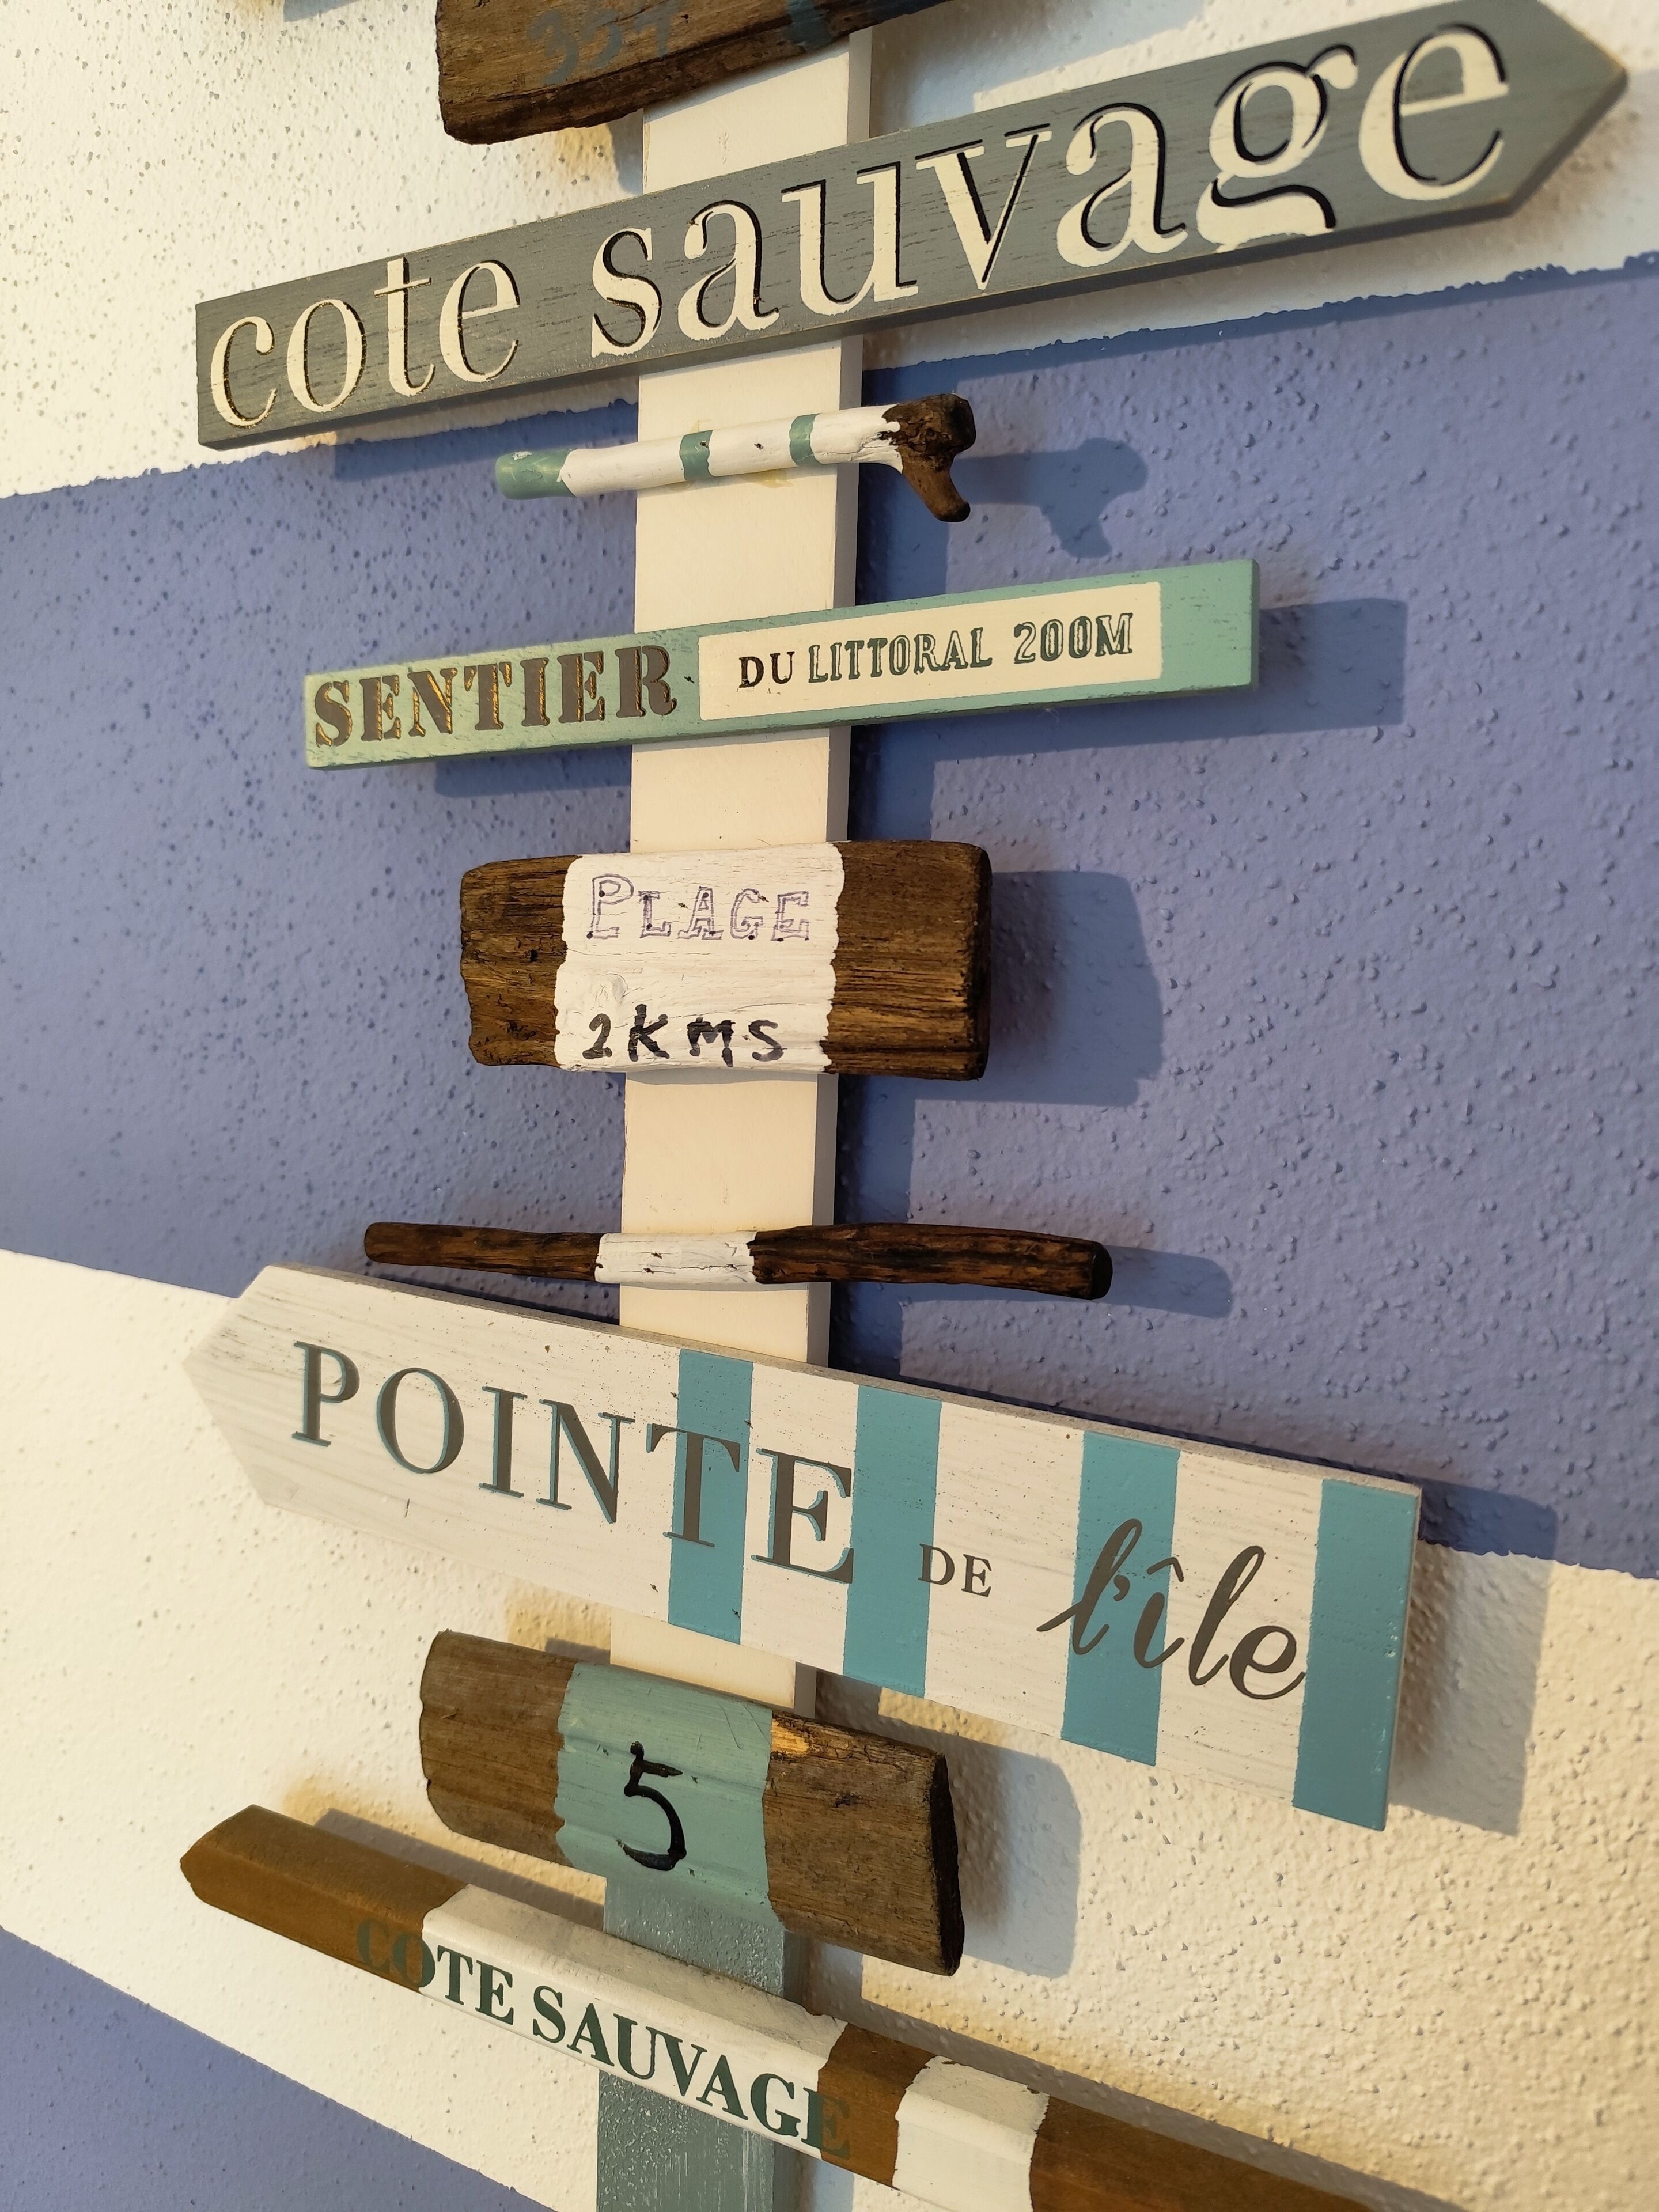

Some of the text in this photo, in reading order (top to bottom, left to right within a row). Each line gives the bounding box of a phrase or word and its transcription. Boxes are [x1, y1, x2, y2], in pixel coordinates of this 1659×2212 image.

[210, 22, 1510, 429] cote sauvage
[314, 612, 1133, 748] SENTIER DU LITTORAL 200M
[585, 873, 810, 942] PLAGE
[290, 1340, 855, 1584] POINTE
[917, 1543, 993, 1597] DE
[615, 1740, 688, 1872] 5
[355, 1918, 853, 2159] COTE SAUVAGE
